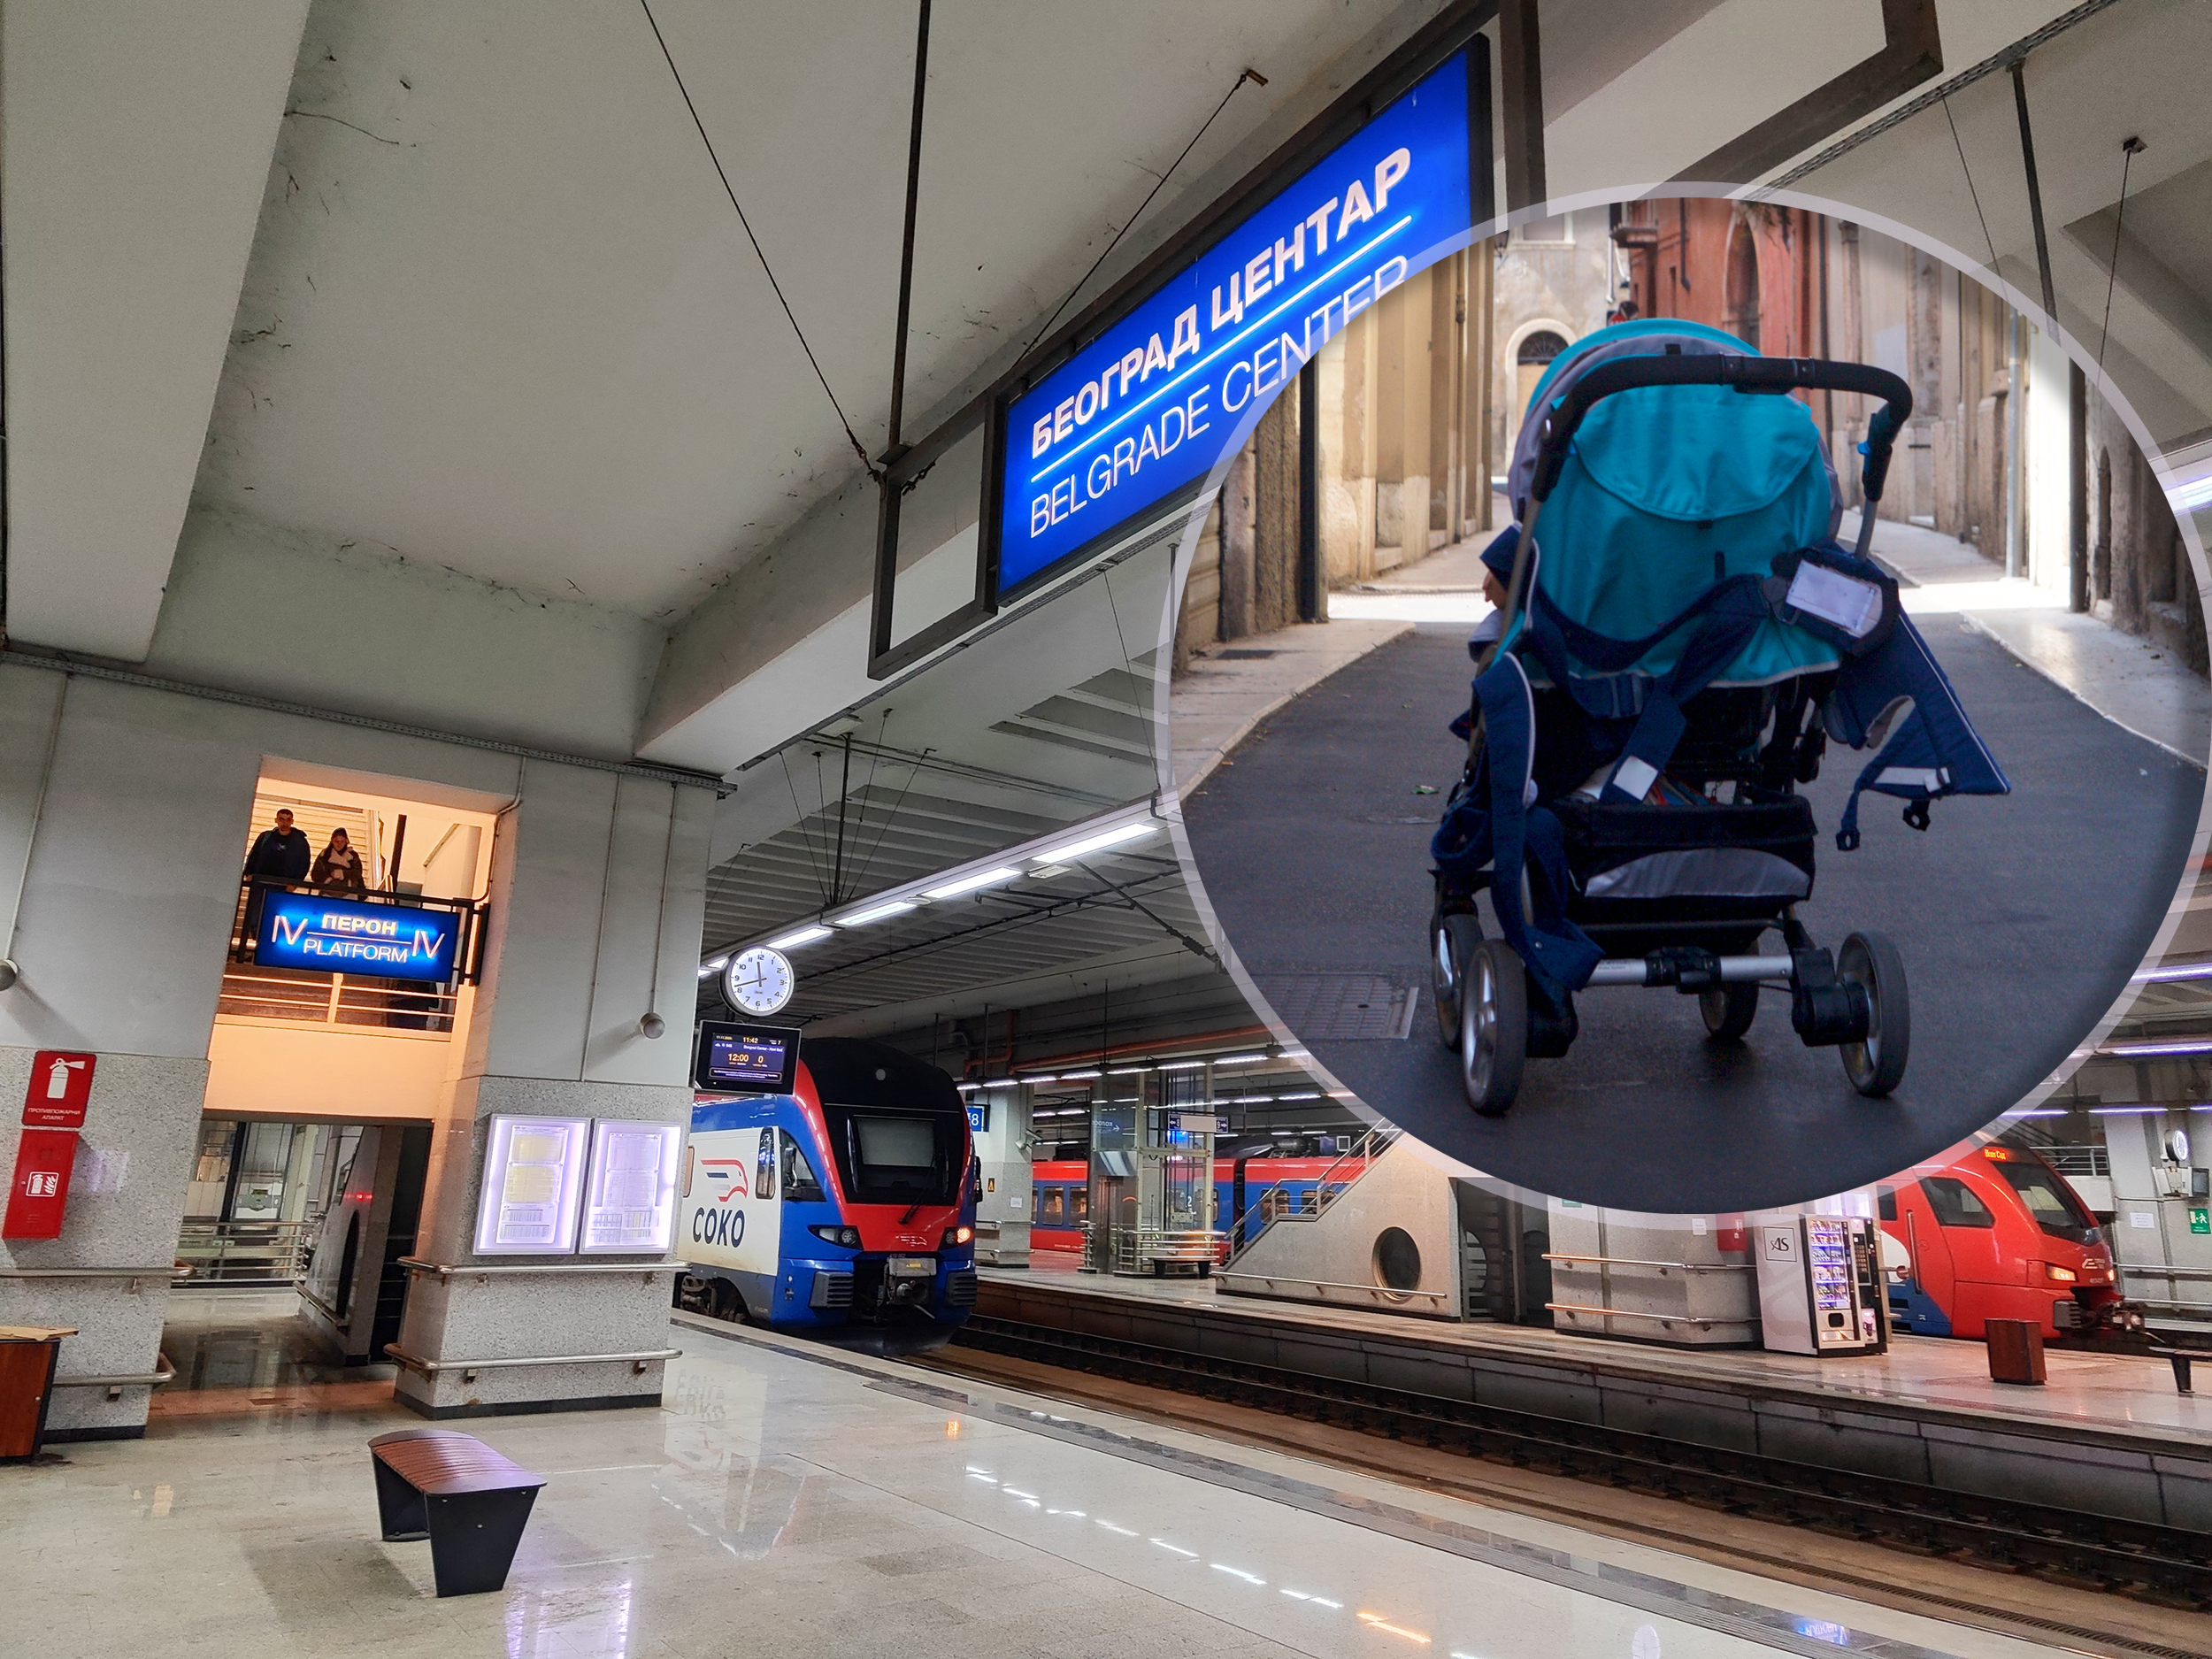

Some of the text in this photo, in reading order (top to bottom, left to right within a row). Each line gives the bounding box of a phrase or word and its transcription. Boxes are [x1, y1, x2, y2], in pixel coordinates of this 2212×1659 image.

[1032, 147, 1411, 459] БЕОГРАД ЦЕНТАР
[1031, 384, 1210, 539] BELGRADE
[272, 915, 309, 946] IV
[321, 914, 397, 935] ПЕРОН
[303, 939, 408, 963] PLATFORM
[411, 929, 445, 958] IV
[728, 1053, 749, 1062] 12:00
[972, 1113, 979, 1125] 8
